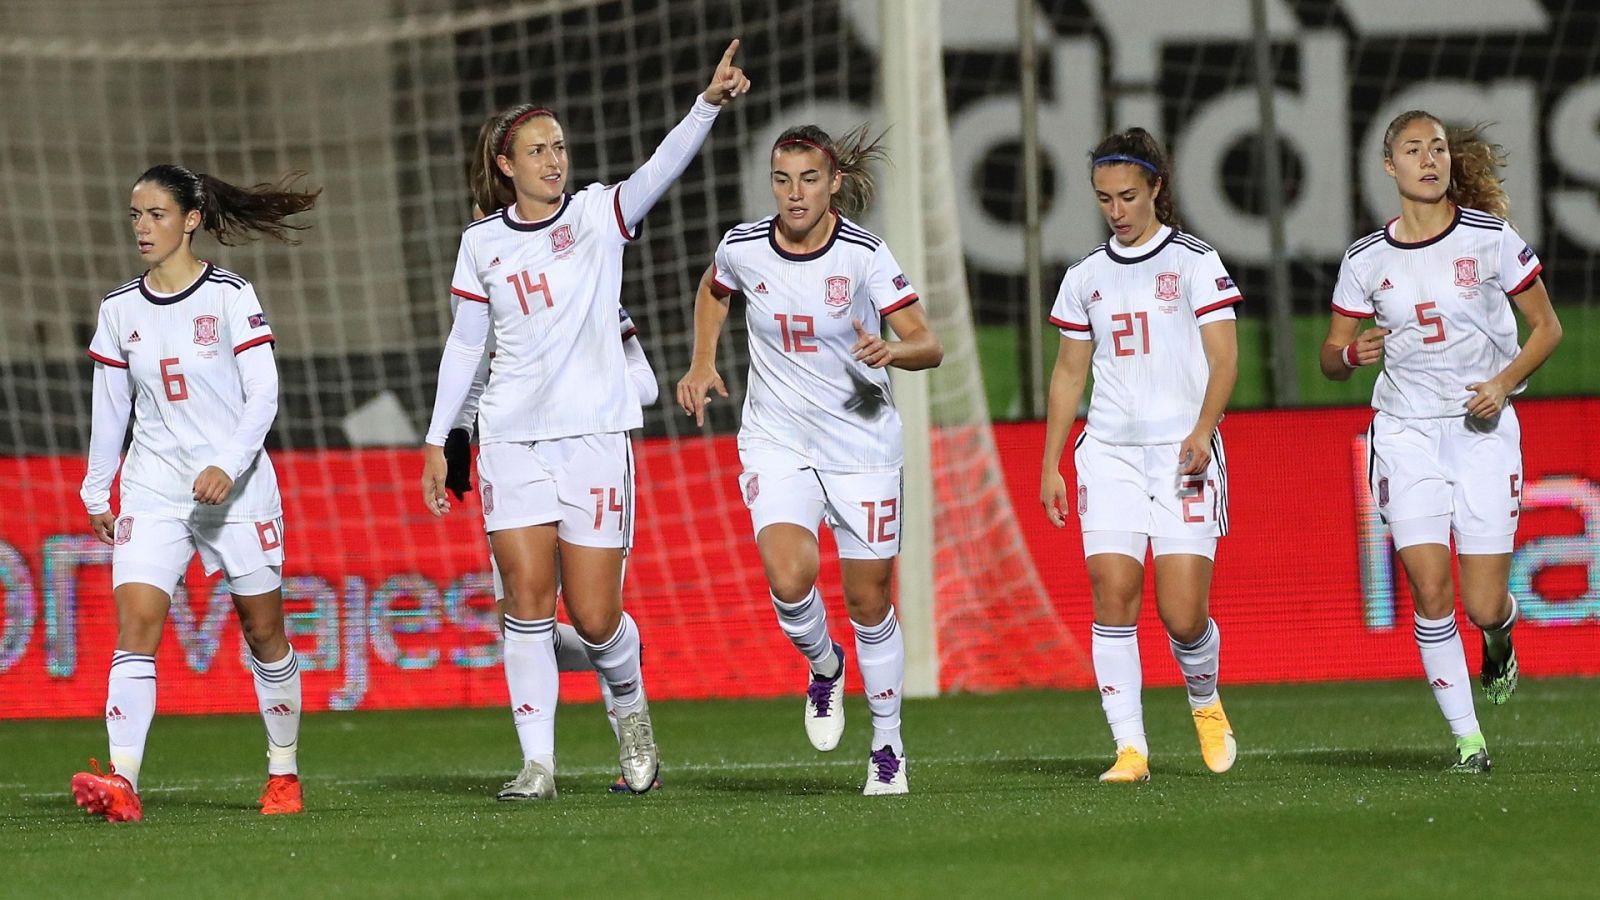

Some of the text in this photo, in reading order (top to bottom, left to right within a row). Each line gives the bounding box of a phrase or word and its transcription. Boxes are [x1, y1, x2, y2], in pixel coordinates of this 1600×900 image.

[506, 271, 554, 315] 14
[774, 312, 818, 353] 12
[1111, 310, 1150, 358] 21
[1415, 302, 1447, 345] 5
[159, 357, 189, 401] 6
[589, 487, 624, 531] 14
[860, 499, 897, 543] 12
[1182, 480, 1218, 523] 21
